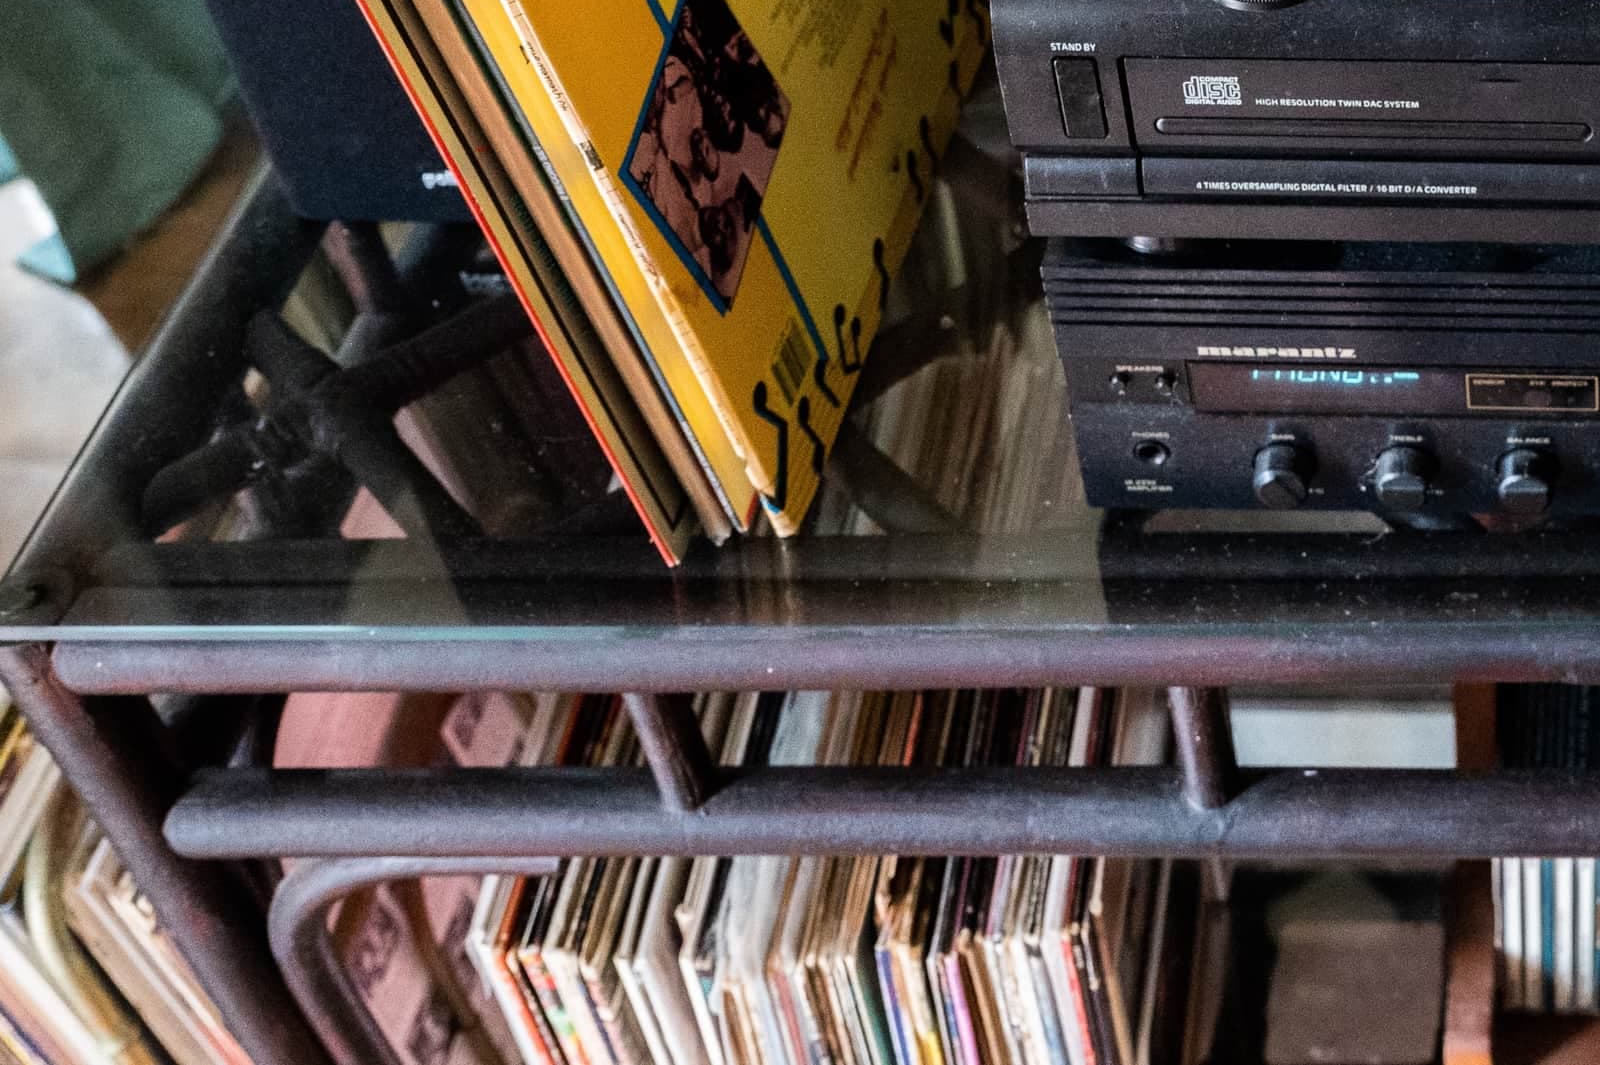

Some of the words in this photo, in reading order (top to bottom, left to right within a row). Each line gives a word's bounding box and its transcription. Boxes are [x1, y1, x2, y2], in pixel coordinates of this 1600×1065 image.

[1050, 43, 1081, 52] STAND
[1083, 43, 1096, 53] BY
[1280, 99, 1336, 107] RESOLUTION
[1384, 101, 1419, 109] SYSTEM
[1203, 182, 1230, 190] TIMES
[1231, 182, 1300, 192] OVERSAMPLING
[1301, 184, 1336, 193] DIGITAL
[1337, 184, 1367, 193] FILTER
[1389, 185, 1403, 193] BIT
[1404, 185, 1424, 194] D/A
[1424, 186, 1478, 195] CONVERTER
[1197, 346, 1357, 358] marantz
